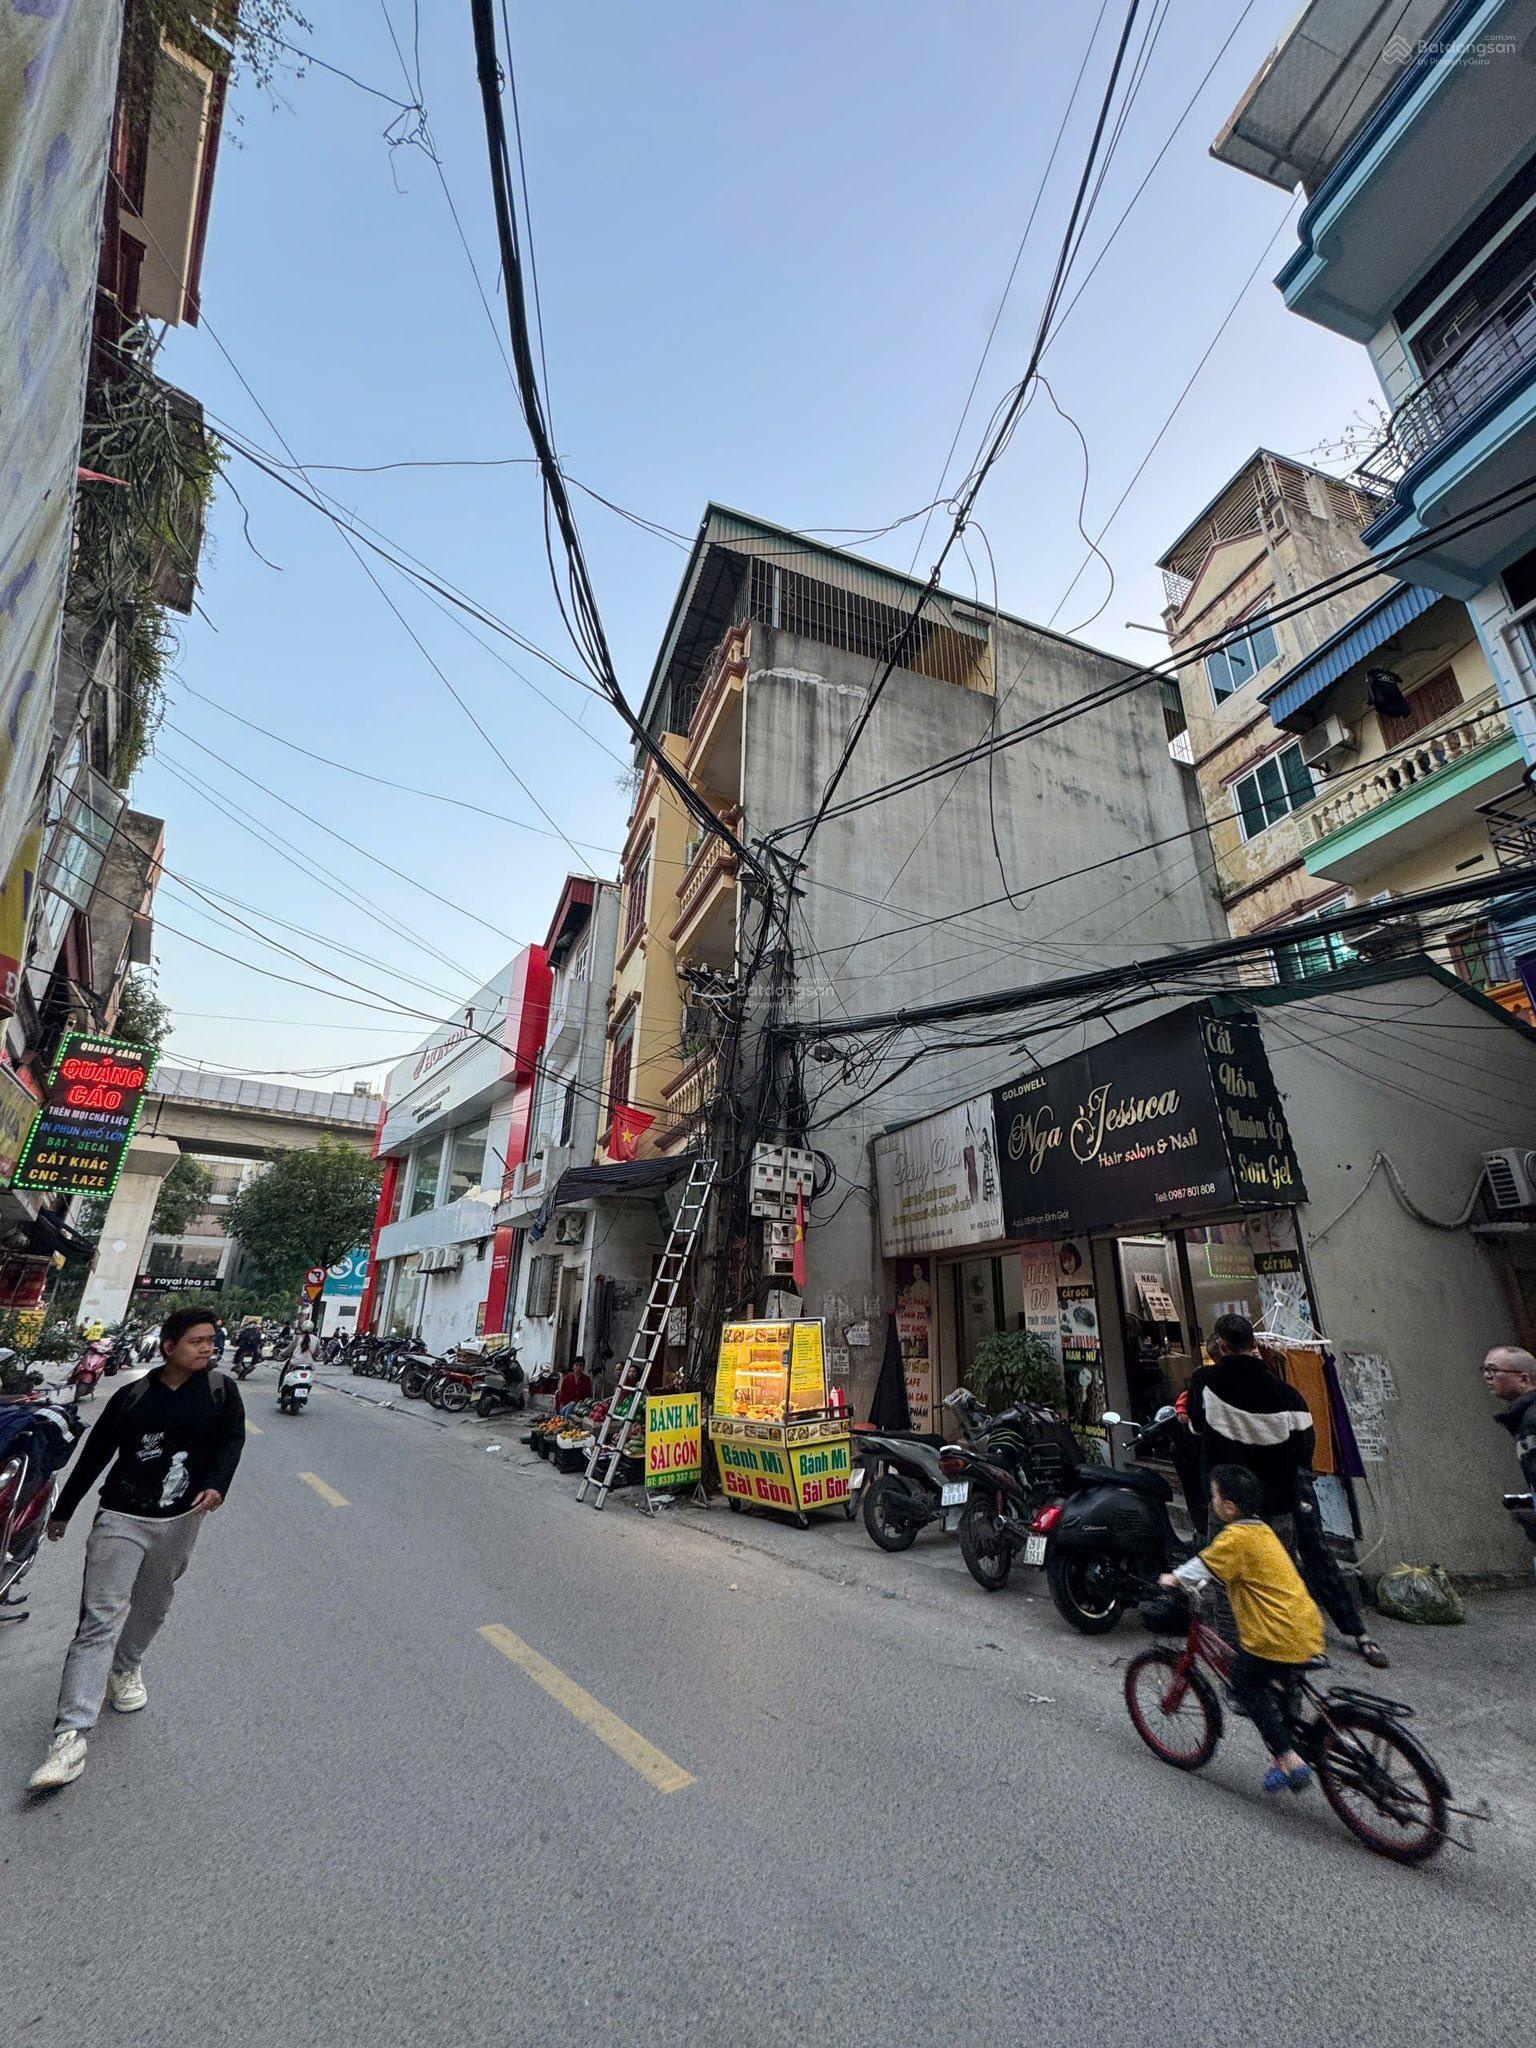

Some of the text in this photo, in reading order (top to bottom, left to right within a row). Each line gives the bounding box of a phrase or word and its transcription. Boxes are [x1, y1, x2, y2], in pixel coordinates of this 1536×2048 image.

[81, 1042, 142, 1061] QUANG SÁNG
[62, 1056, 145, 1088] QUẢNG
[68, 1085, 121, 1108] CÁO
[1002, 1077, 1047, 1101] GOLDWELL
[49, 1106, 71, 1117] TRÊN
[71, 1109, 89, 1121] MỌI
[40, 1122, 51, 1131] IN
[53, 1124, 80, 1135] PHUN
[1008, 1082, 1180, 1174] Nga Jessica
[78, 1141, 109, 1153] DECAL
[1098, 1127, 1199, 1168] Hair salon & Nail
[29, 1169, 59, 1181] CNC
[72, 1174, 106, 1187] LAZE
[1168, 1187, 1187, 1200] 0987
[1187, 1186, 1200, 1197] 801
[1200, 1183, 1216, 1196] 808
[154, 1277, 182, 1286] royal
[184, 1277, 202, 1286] tea
[650, 1396, 698, 1432] BÁNH MÌ
[650, 1434, 698, 1470] SÀI GÒN
[721, 1443, 785, 1475] Bánh Mì
[799, 1447, 847, 1476] Bánh Mì
[725, 1470, 793, 1506] Sài Gòn
[802, 1479, 823, 1505] Sài
